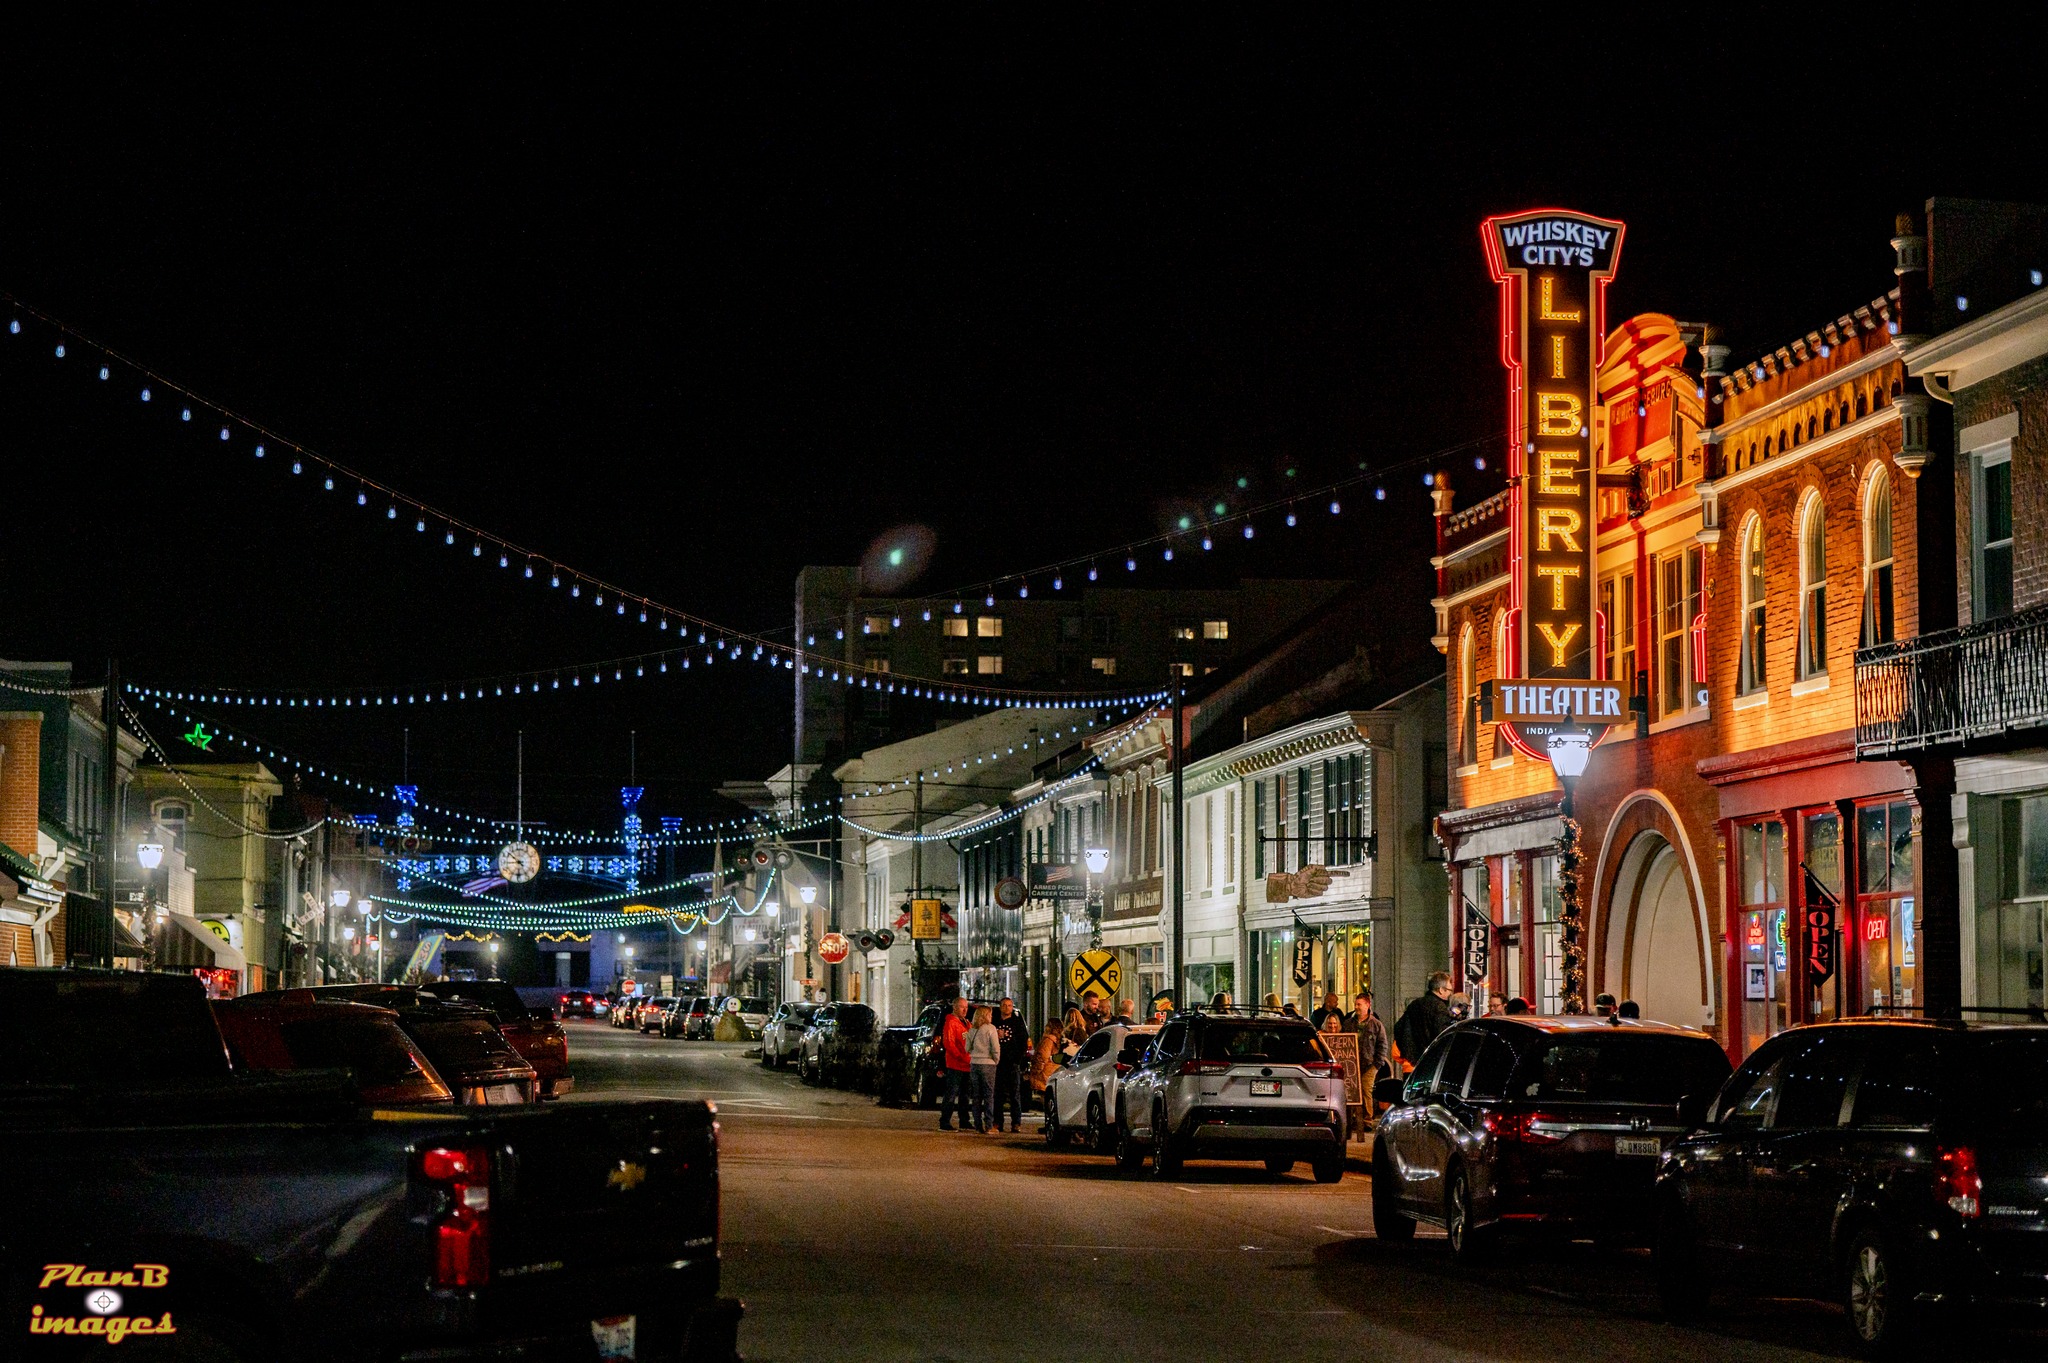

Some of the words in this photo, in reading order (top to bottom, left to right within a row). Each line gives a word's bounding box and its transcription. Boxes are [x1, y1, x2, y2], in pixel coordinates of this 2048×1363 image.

[1503, 220, 1611, 250] WHISKEY
[1523, 245, 1594, 267] CITY'S
[1535, 276, 1583, 668] LIBERTY
[1500, 685, 1622, 716] THEATER
[1808, 911, 1830, 975] OPEN
[1867, 919, 1886, 940] OPEN
[821, 942, 847, 955] STOP
[1294, 940, 1311, 981] OPEN
[1468, 928, 1485, 976] OPEN
[1075, 969, 1085, 981] R
[1108, 970, 1118, 982] R
